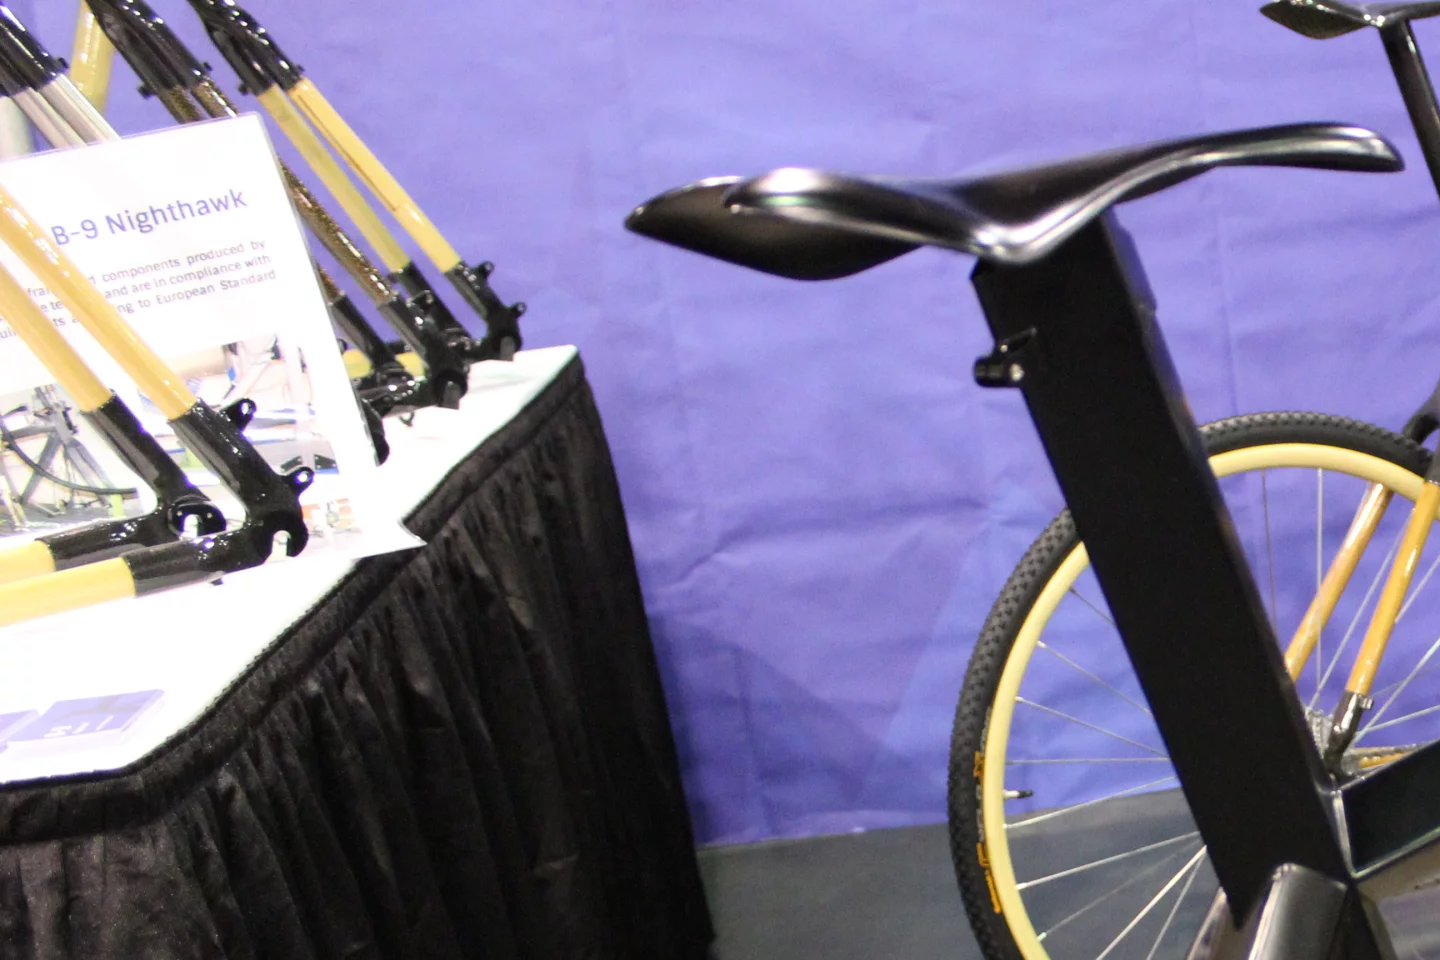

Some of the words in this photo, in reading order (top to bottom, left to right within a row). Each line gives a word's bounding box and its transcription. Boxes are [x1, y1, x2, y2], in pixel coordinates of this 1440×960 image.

[51, 219, 98, 245] B-9
[105, 188, 247, 234] Nighthawk
[102, 258, 181, 282] components
[186, 243, 245, 266] produced
[250, 239, 265, 252] by
[104, 285, 129, 299] and
[132, 281, 151, 293] are
[154, 277, 167, 288] in
[169, 261, 242, 285] compliance
[244, 254, 271, 268] with
[137, 298, 151, 309] to
[156, 284, 216, 305] European
[220, 269, 276, 291] Standard
